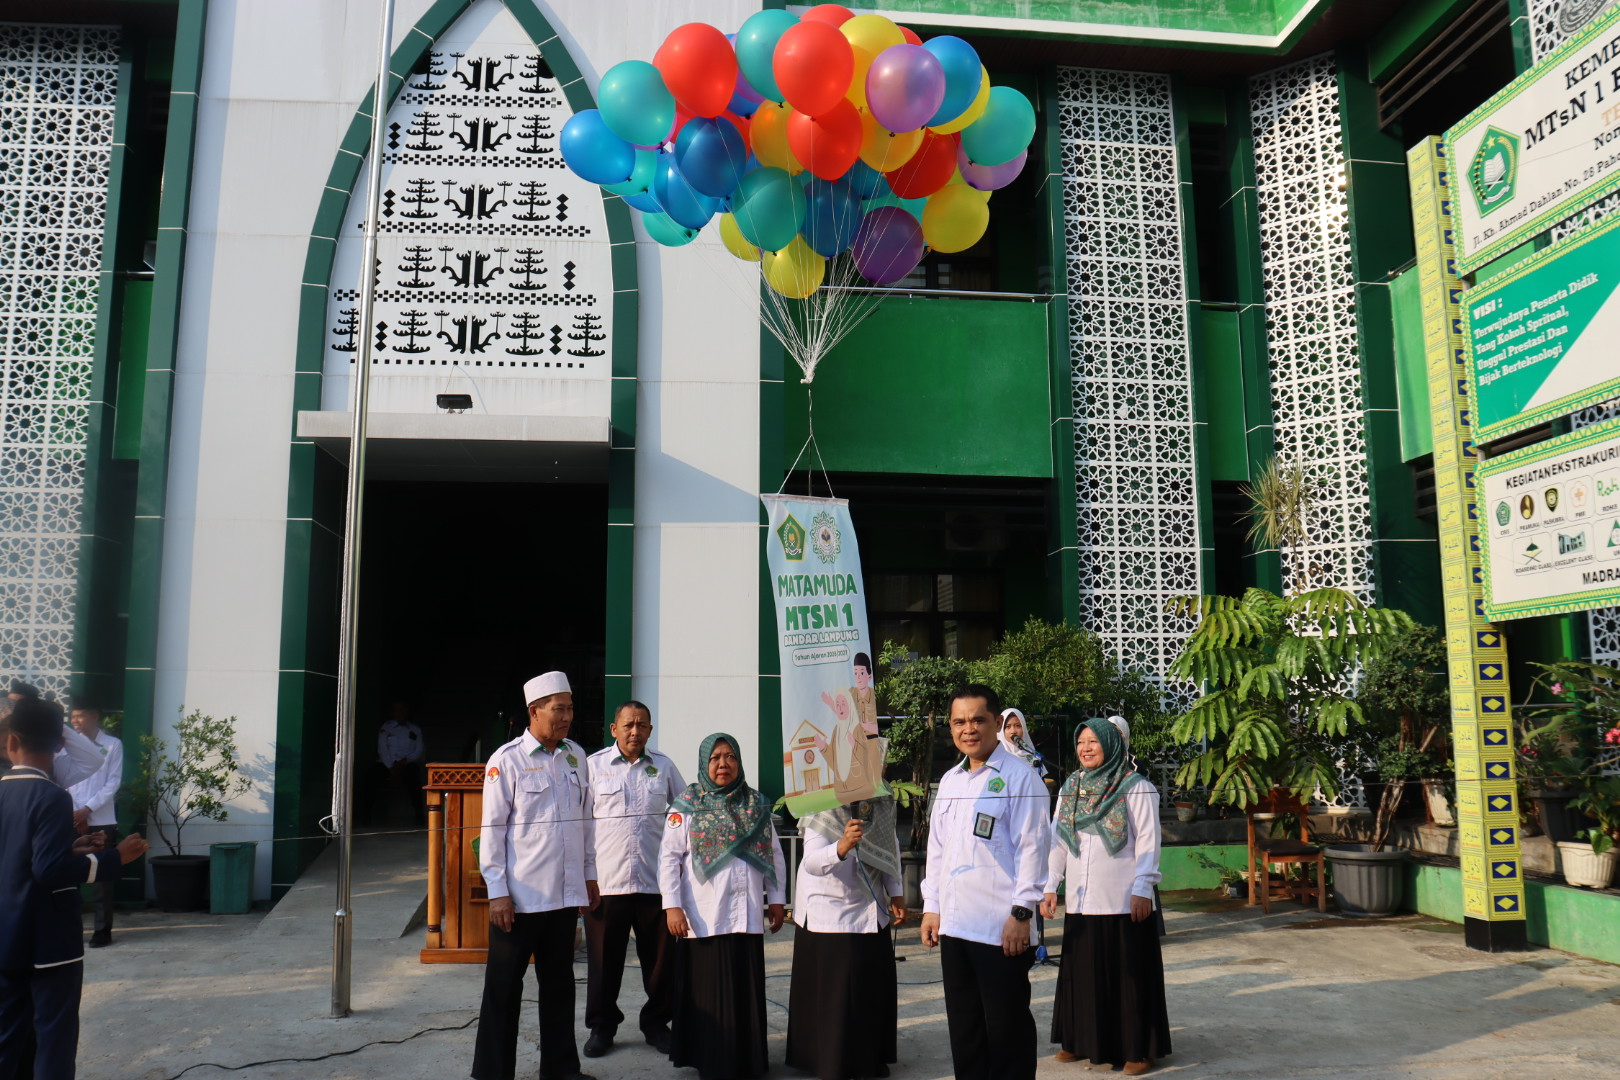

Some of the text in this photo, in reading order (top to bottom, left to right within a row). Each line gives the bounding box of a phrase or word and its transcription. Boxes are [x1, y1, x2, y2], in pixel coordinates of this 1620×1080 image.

[1525, 90, 1586, 150] MTsN
[1499, 206, 1528, 232] Ahmad
[1530, 188, 1563, 213] Dahlan
[1564, 178, 1581, 192] No.
[1473, 299, 1496, 320] VISI
[1474, 272, 1599, 339] Terwujudnya Peserta Didik
[1475, 339, 1497, 355] Yang
[1497, 325, 1526, 346] Kokoh
[1477, 325, 1568, 371] Unggul Prestasi Dan
[1478, 342, 1563, 386] Bijak Berteknologi
[1506, 445, 1620, 490] KEGIATAN EKSTRAKURI
[777, 573, 858, 598] MATAMUDA
[784, 629, 859, 647] BANDAR LAMPUNG
[785, 603, 854, 631] MTSN 1
